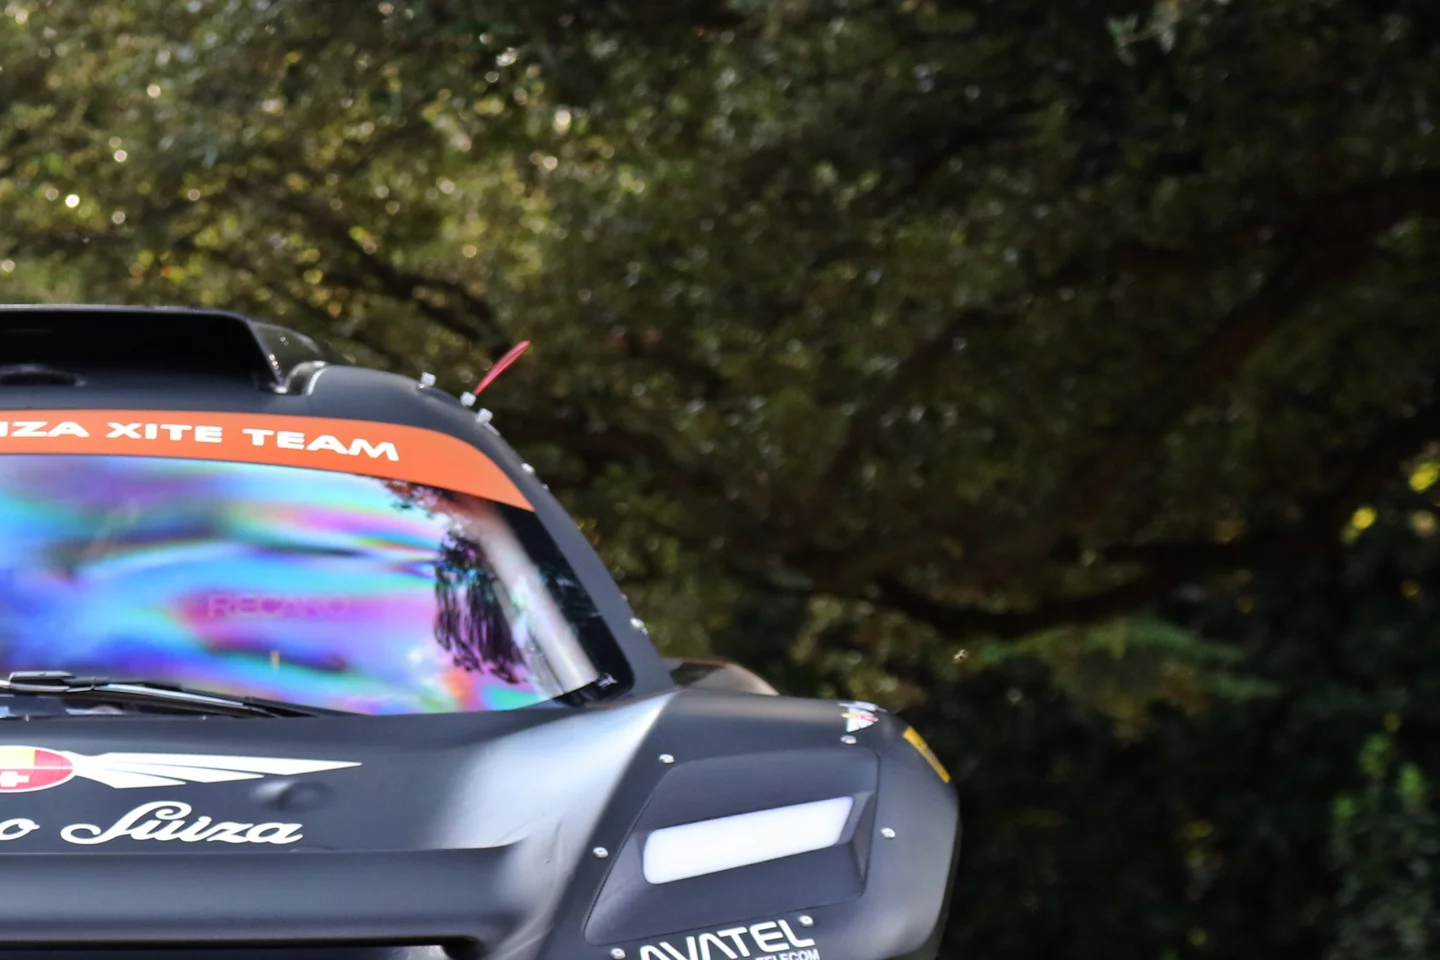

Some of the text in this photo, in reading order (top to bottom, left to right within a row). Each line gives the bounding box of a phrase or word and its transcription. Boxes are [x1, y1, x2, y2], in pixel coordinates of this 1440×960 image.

[106, 422, 223, 443] XITE
[242, 428, 399, 462] TEAM
[60, 800, 305, 846] Suiza
